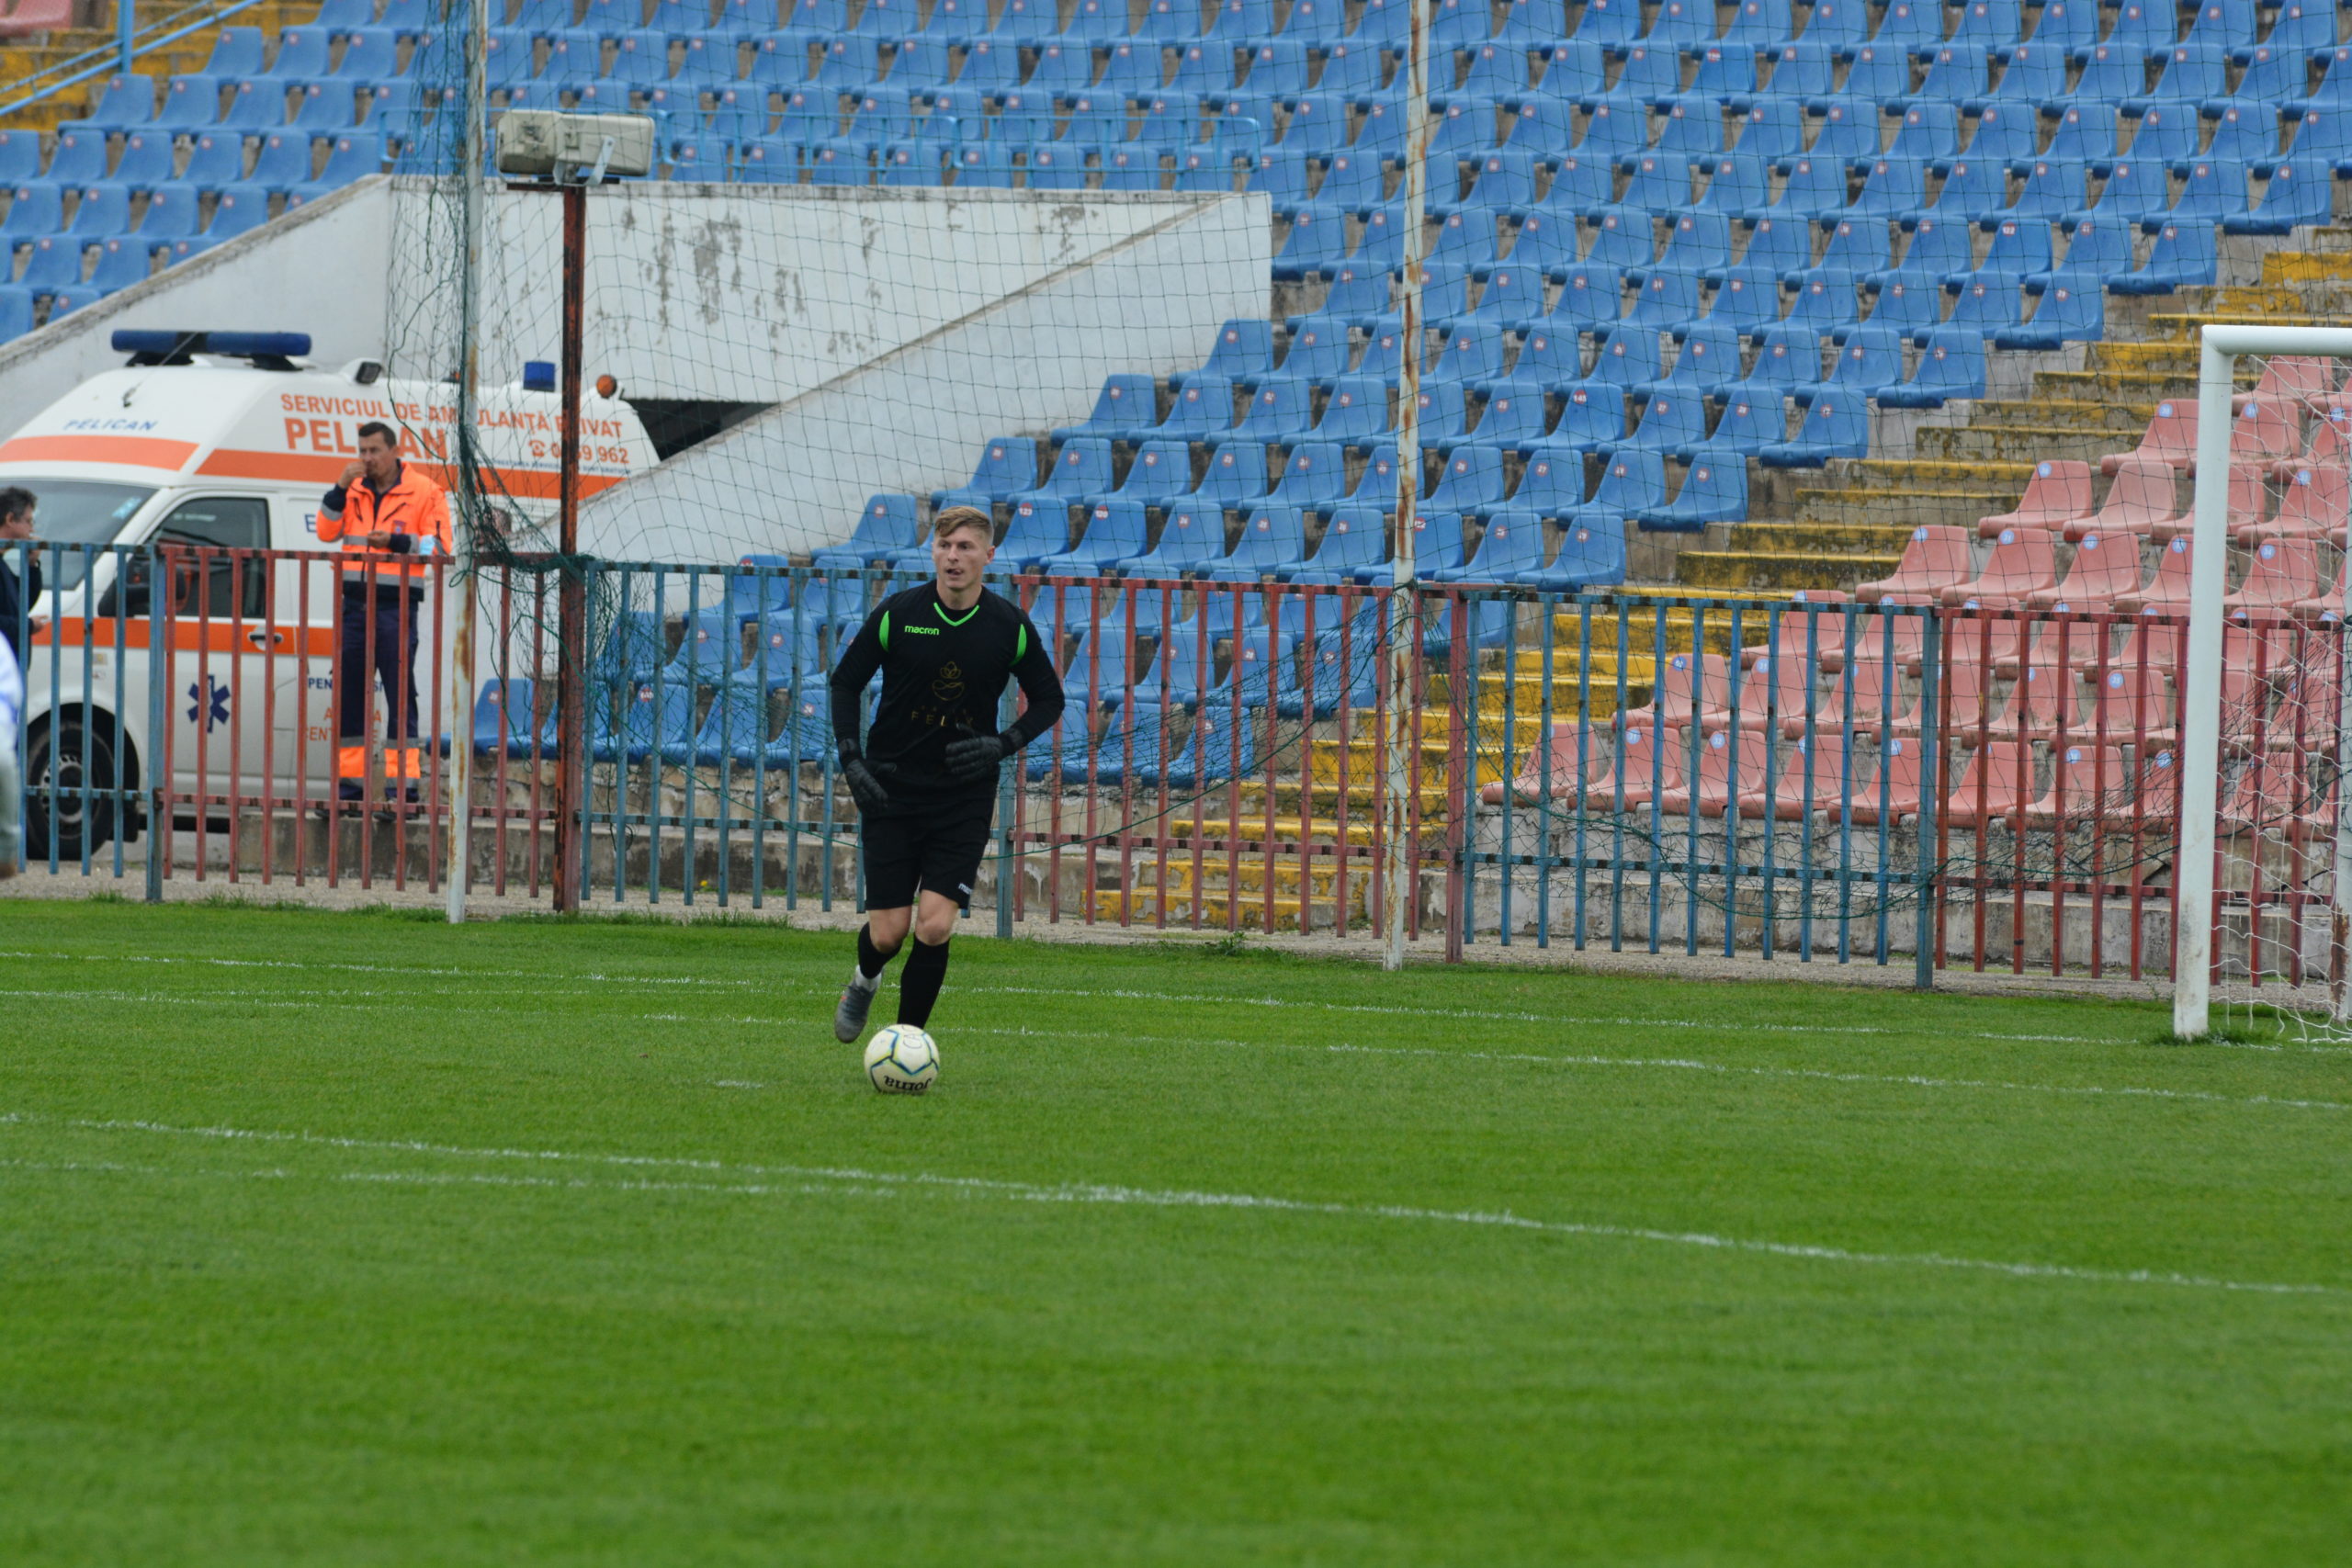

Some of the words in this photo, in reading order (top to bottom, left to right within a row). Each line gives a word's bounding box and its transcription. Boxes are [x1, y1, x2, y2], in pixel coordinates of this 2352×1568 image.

[280, 393, 390, 418] SERVICIUL
[396, 402, 423, 421] DE
[555, 415, 623, 438] PIVAT
[62, 419, 158, 431] PELICAN
[284, 417, 448, 460] PELAN
[598, 446, 630, 464] 962
[904, 625, 940, 636] macron
